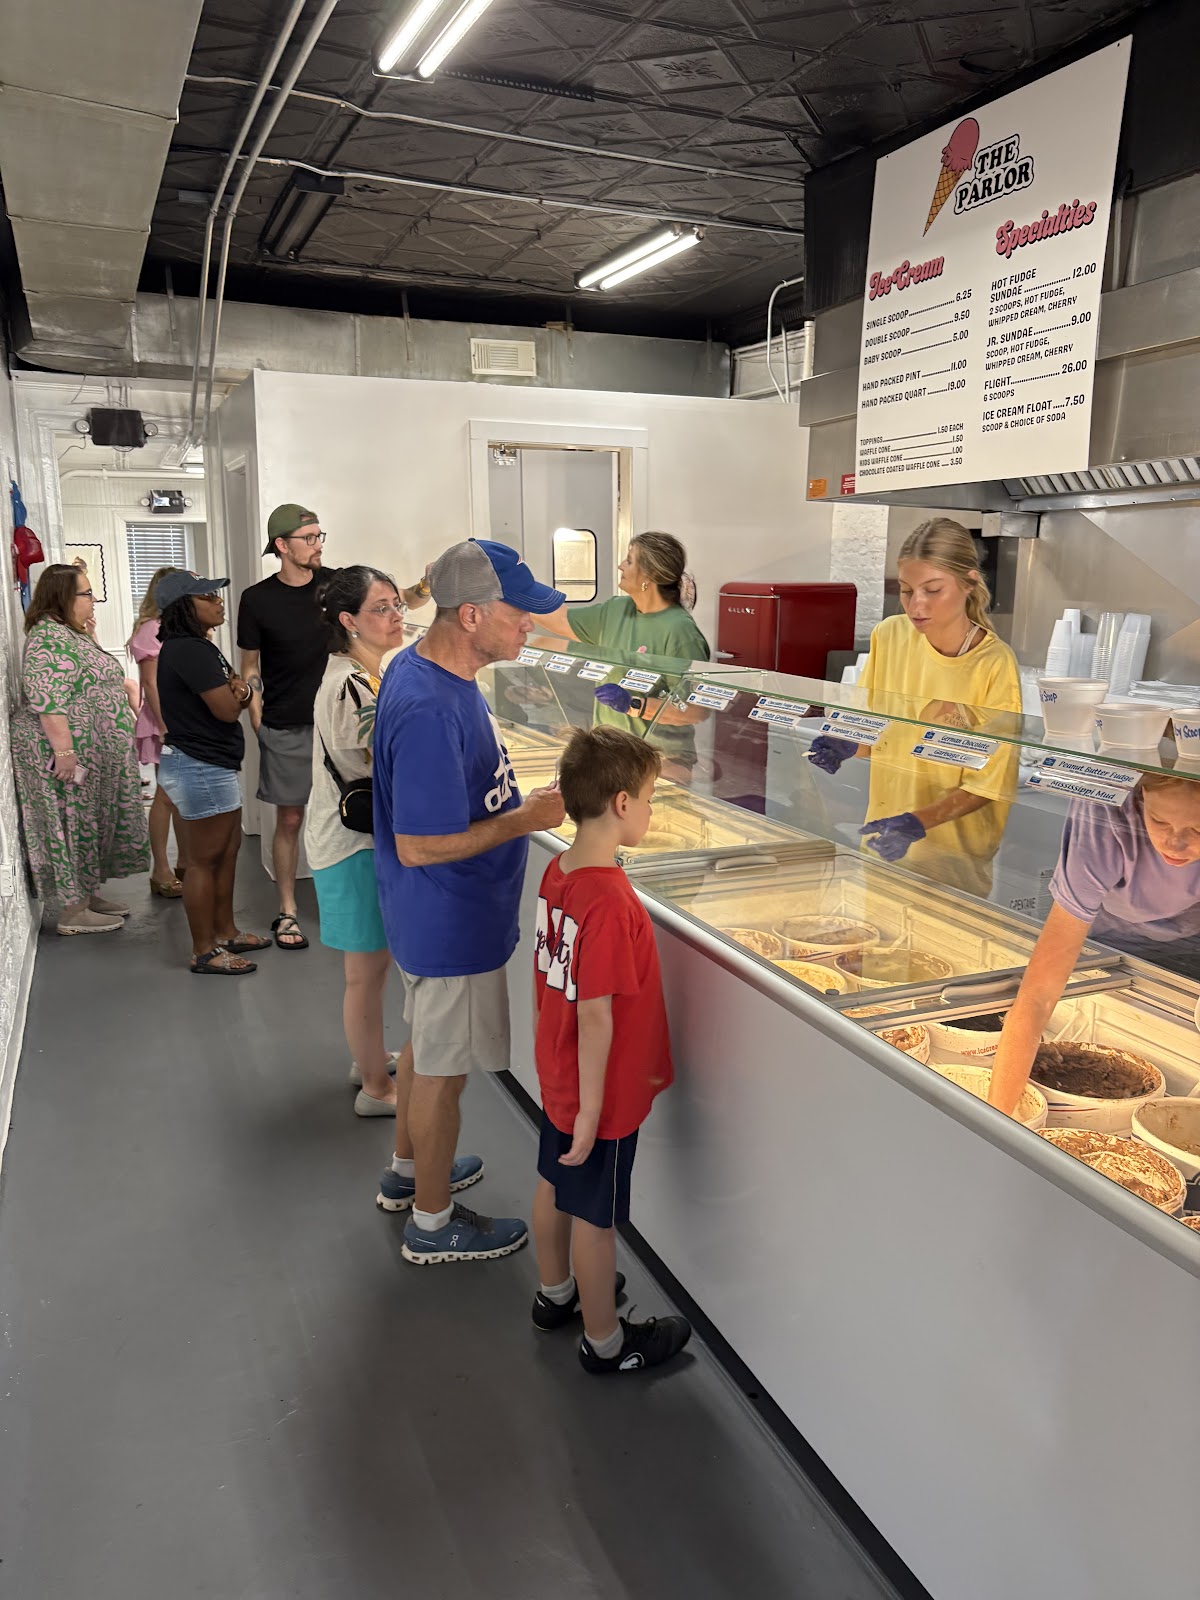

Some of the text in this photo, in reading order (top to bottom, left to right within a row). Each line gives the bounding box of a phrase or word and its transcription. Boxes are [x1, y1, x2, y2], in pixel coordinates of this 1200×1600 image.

[977, 139, 1018, 175] THE
[957, 162, 1031, 210] PARLOR
[996, 199, 1097, 259] Specialties
[869, 256, 944, 301] Ice Cream
[990, 262, 1097, 303] SUNDAE 12.00
[991, 268, 1037, 291] HOT FUDGE
[866, 288, 972, 330] SINGLE SCOOP 6.25
[988, 295, 1078, 328] WHIPPED CREAM, CHERRY
[989, 286, 1065, 316] 2 SCOOPS, HOT FUDGE,
[865, 309, 971, 348] DOUBLE SCOOP 9.50
[986, 311, 1092, 348] JR. SUNDAE 9.00
[864, 329, 969, 366] BABY SCOOP 5.00
[985, 343, 1074, 371] WHIPPED CREAM, CHERRY
[986, 336, 1050, 359] SCOOP, HOT FUDGE,
[862, 359, 967, 392] HAND PACKED PINT 11.00
[984, 359, 1088, 390] FLIGHT 26.00
[861, 378, 966, 409] HAND PACKED QUART 19.00
[983, 388, 1015, 402] 6 SCOOPS
[982, 394, 1085, 421] ICE CREAM FLOAT 7.50
[860, 436, 883, 446] TOPPINGS
[949, 422, 964, 432] EACH
[982, 411, 1066, 433] SCOOP & CHOICE OF SODA
[859, 447, 877, 456] WAFFLE
[878, 445, 891, 454] CONE
[859, 458, 870, 467] KIDS
[871, 455, 889, 465] WAFFLE
[890, 454, 903, 463] CONE
[859, 457, 963, 477] CHOCOLATE COATED WAFFLE CONE 3.50
[852, 731, 878, 741] Chocolate
[861, 717, 886, 728] Chocolate
[934, 749, 960, 759] Garbage
[941, 735, 962, 744] German
[961, 739, 990, 750] Chocolate
[1058, 760, 1084, 771] Peanut
[1084, 766, 1110, 777] Butter
[1109, 771, 1135, 783] Fudge
[1050, 780, 1097, 796] Mississippi
[1095, 790, 1116, 800] Mud
